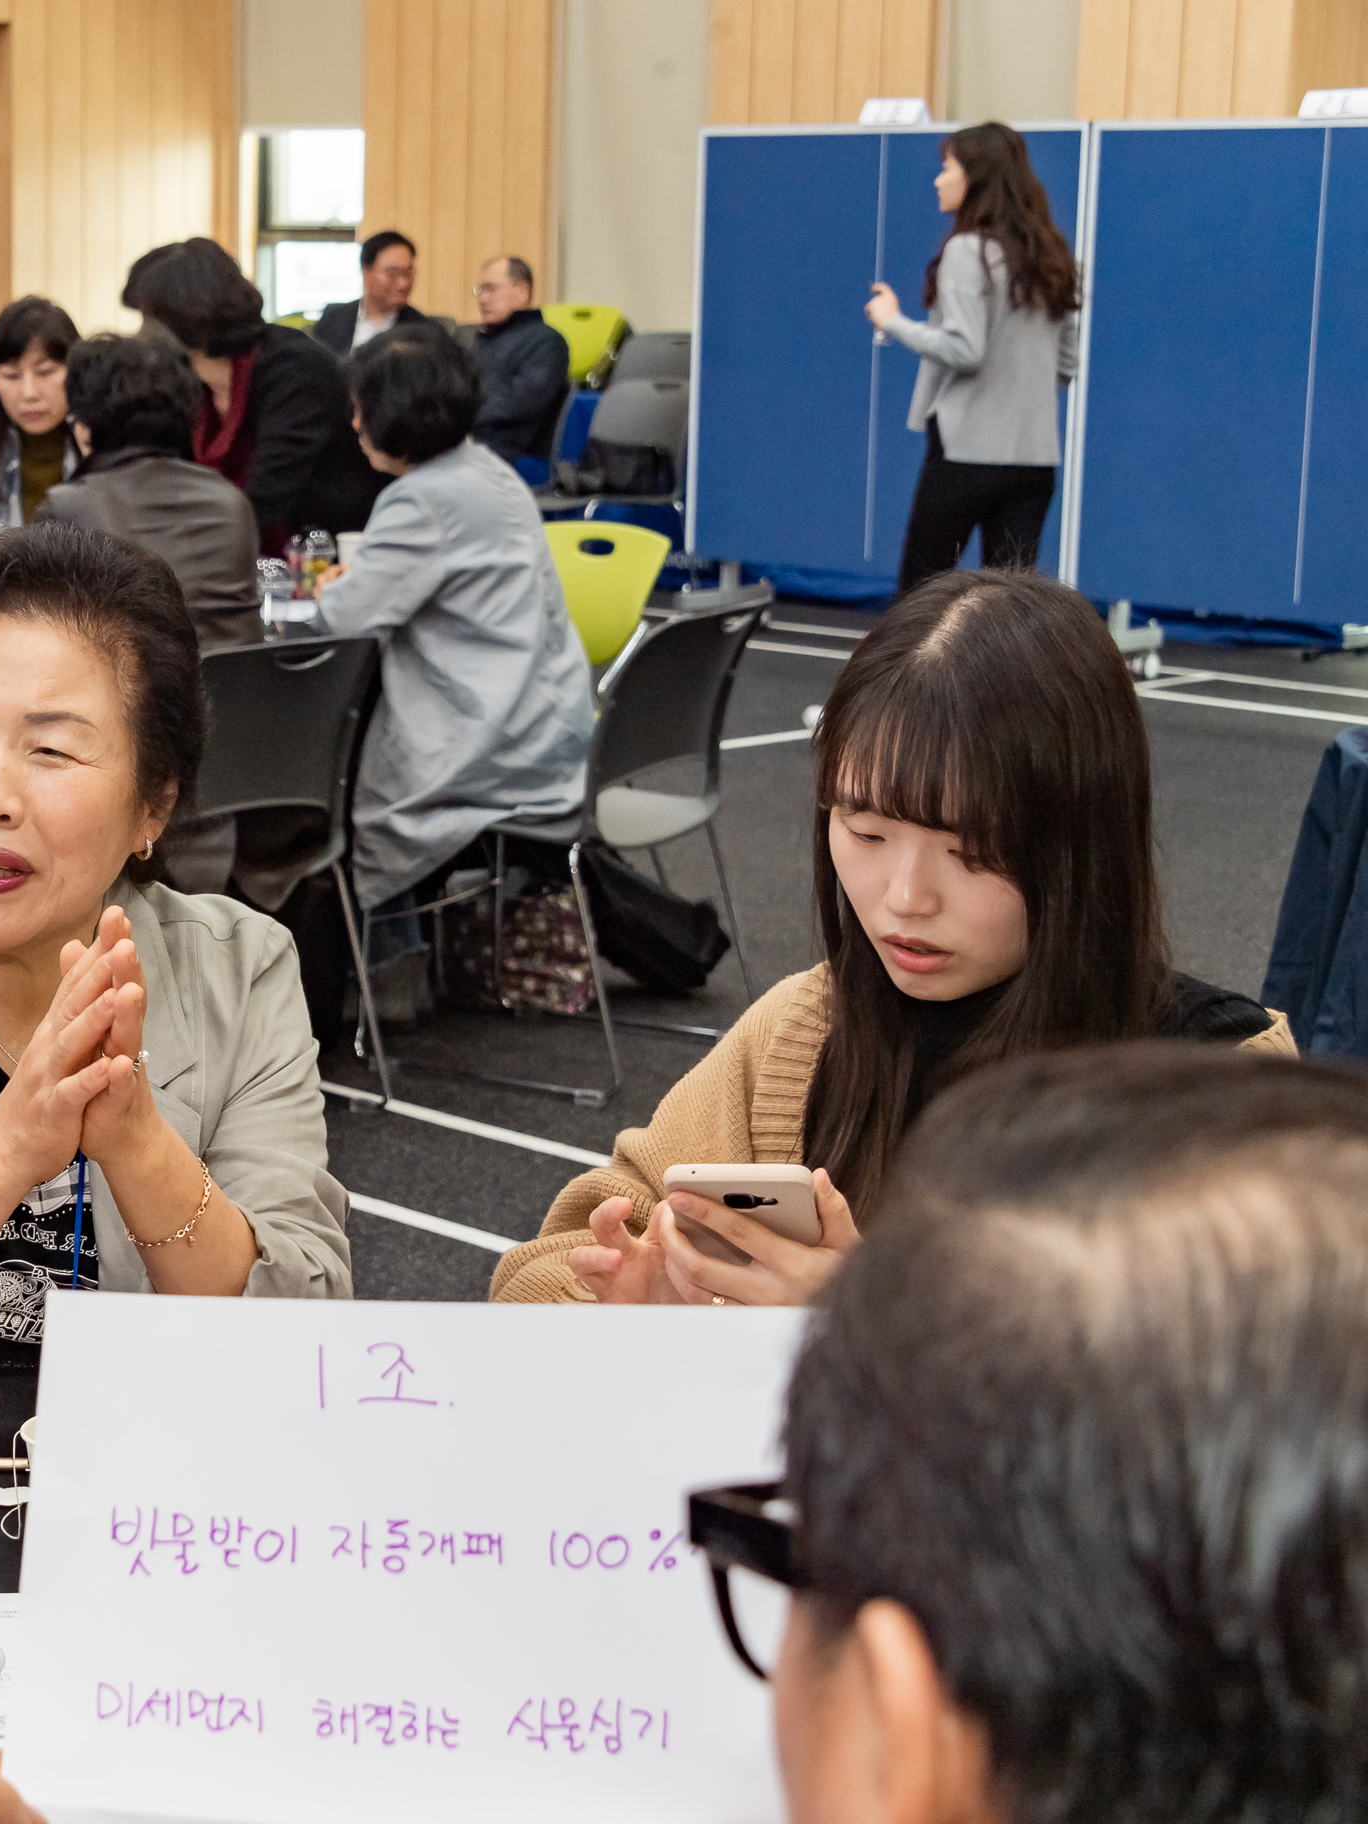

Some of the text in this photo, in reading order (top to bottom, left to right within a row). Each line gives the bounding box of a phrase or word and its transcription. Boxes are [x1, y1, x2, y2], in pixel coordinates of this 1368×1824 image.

[110, 1505, 299, 1577] 빗물받이
[96, 1681, 264, 1734] 미세먼지
[312, 1697, 460, 1750] 해결하는
